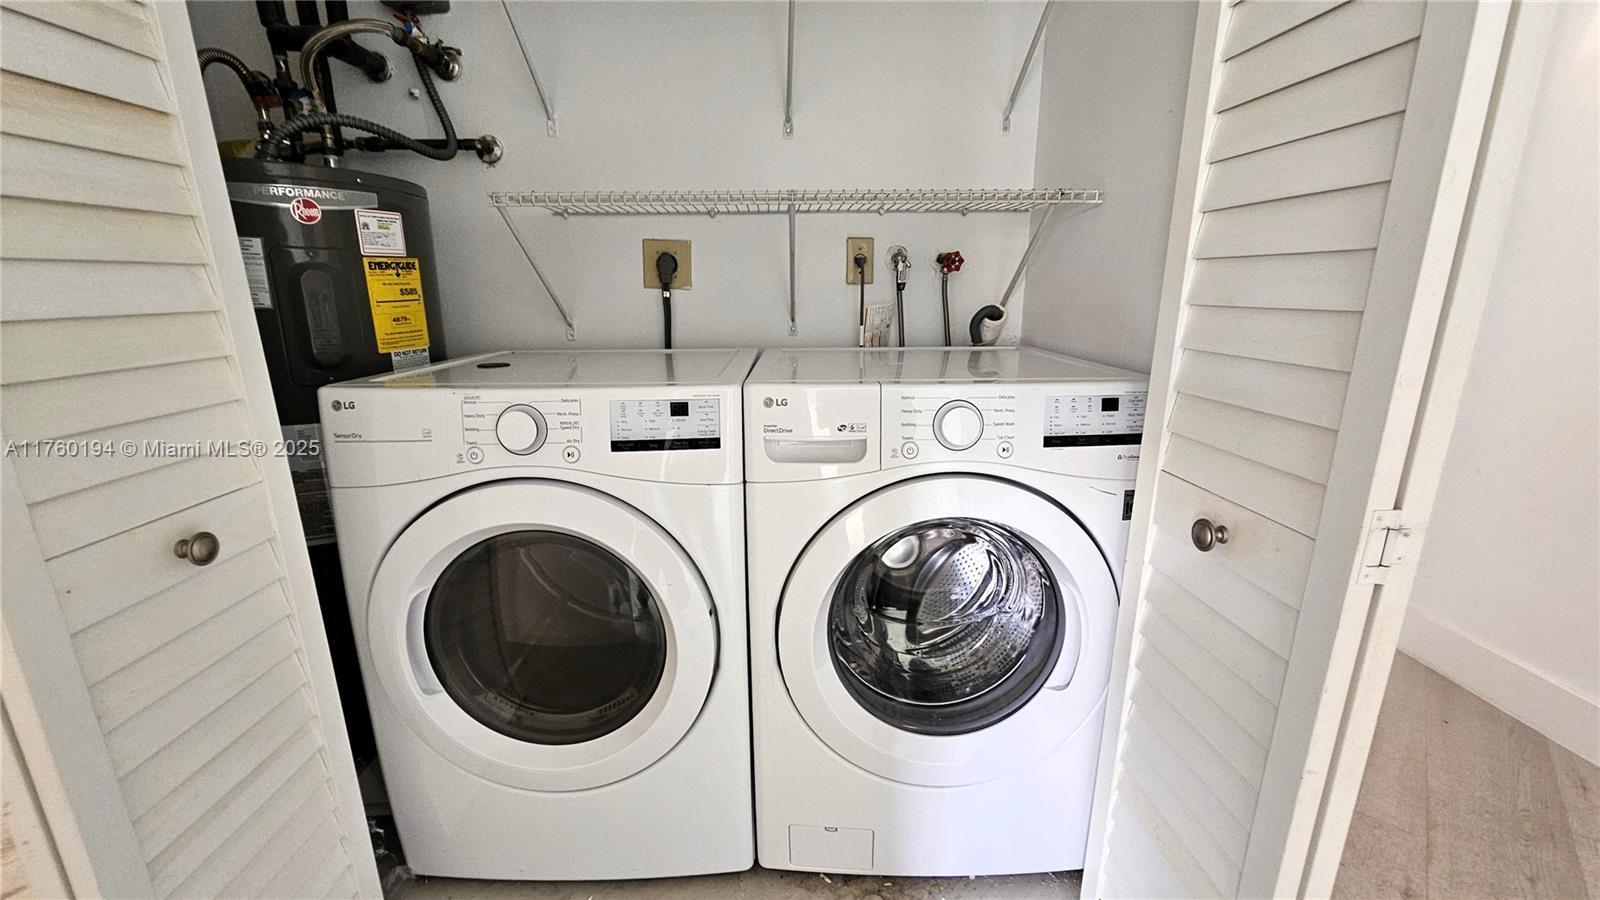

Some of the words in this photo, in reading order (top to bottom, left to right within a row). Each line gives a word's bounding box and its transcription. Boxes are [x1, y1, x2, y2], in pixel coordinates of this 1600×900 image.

[252, 185, 346, 201] PERFORMANCE
[293, 198, 320, 220] Rheem
[343, 401, 355, 410] LG
[775, 398, 788, 407] LG
